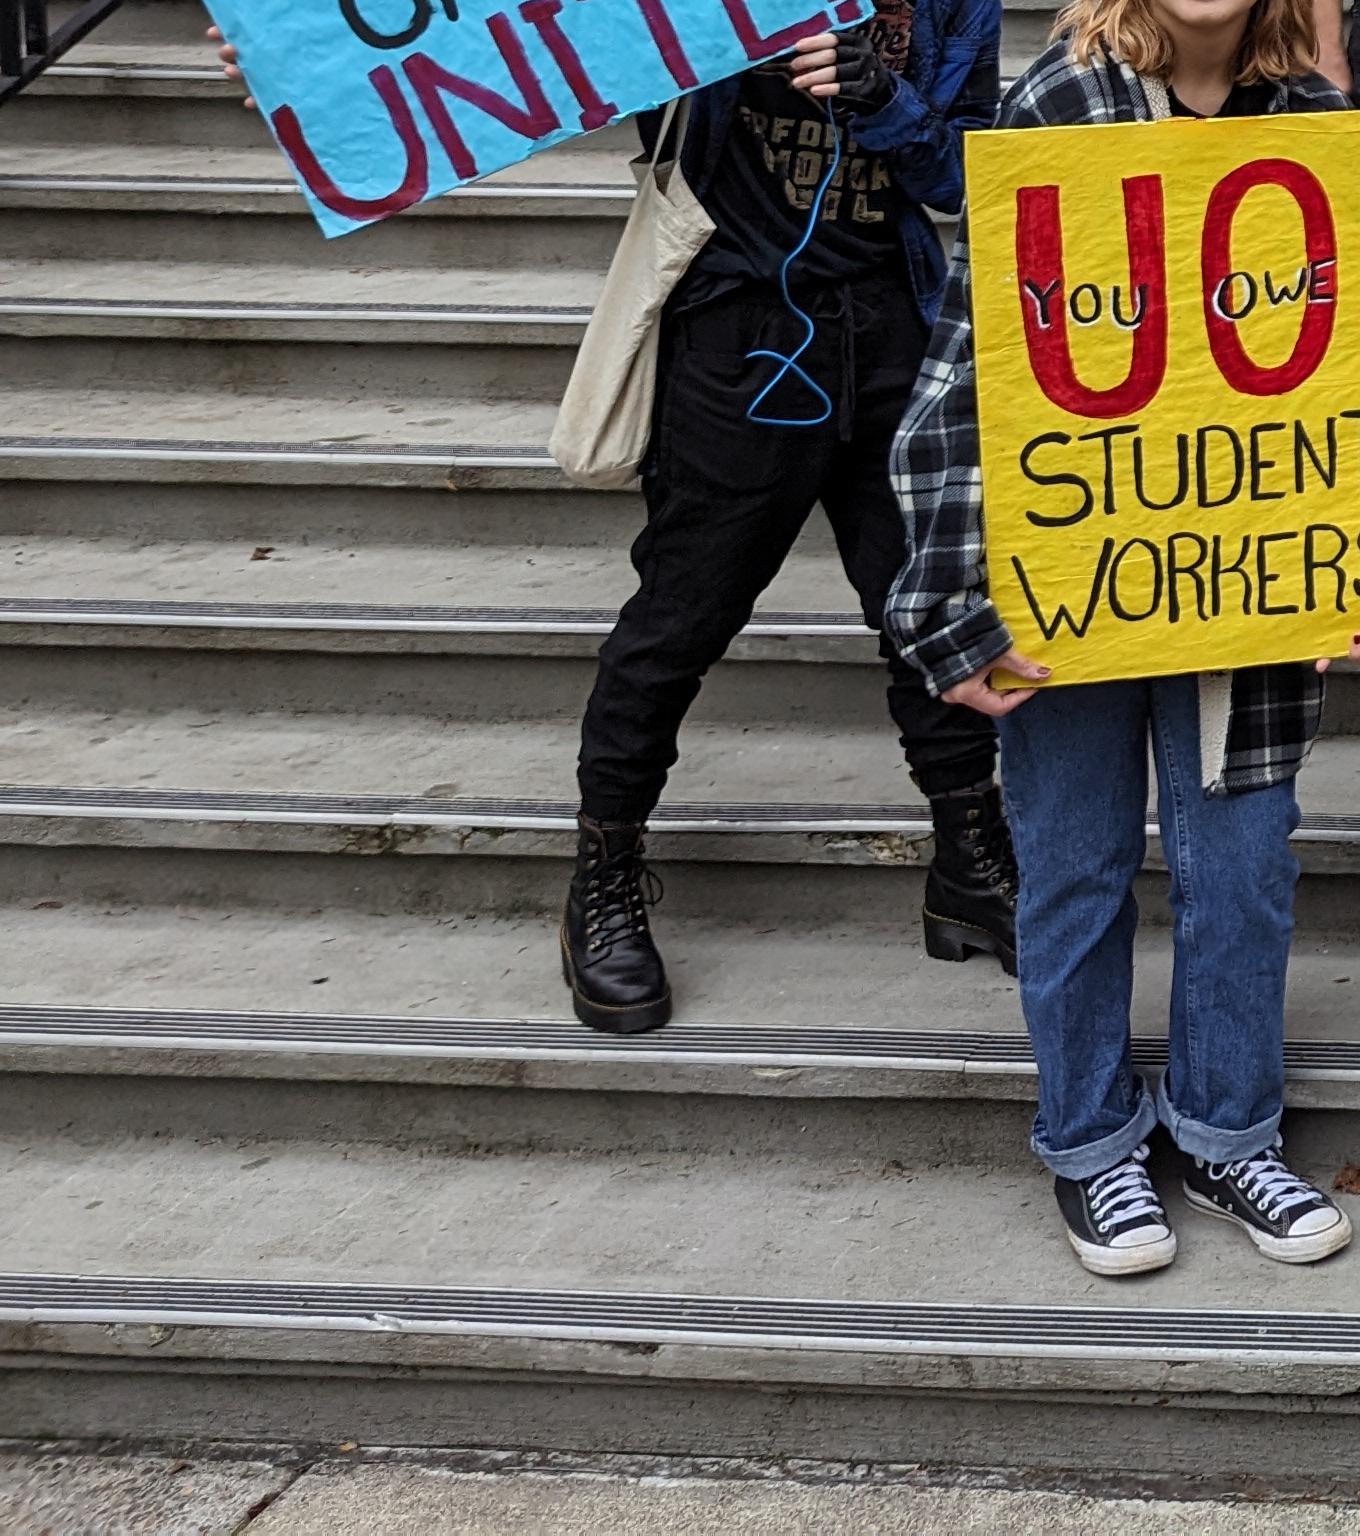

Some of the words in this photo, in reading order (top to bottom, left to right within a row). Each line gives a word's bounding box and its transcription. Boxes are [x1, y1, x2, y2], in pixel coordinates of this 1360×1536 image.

[1016, 158, 1337, 419] UO
[1025, 277, 1147, 330] YOU
[1212, 258, 1337, 322] OWE
